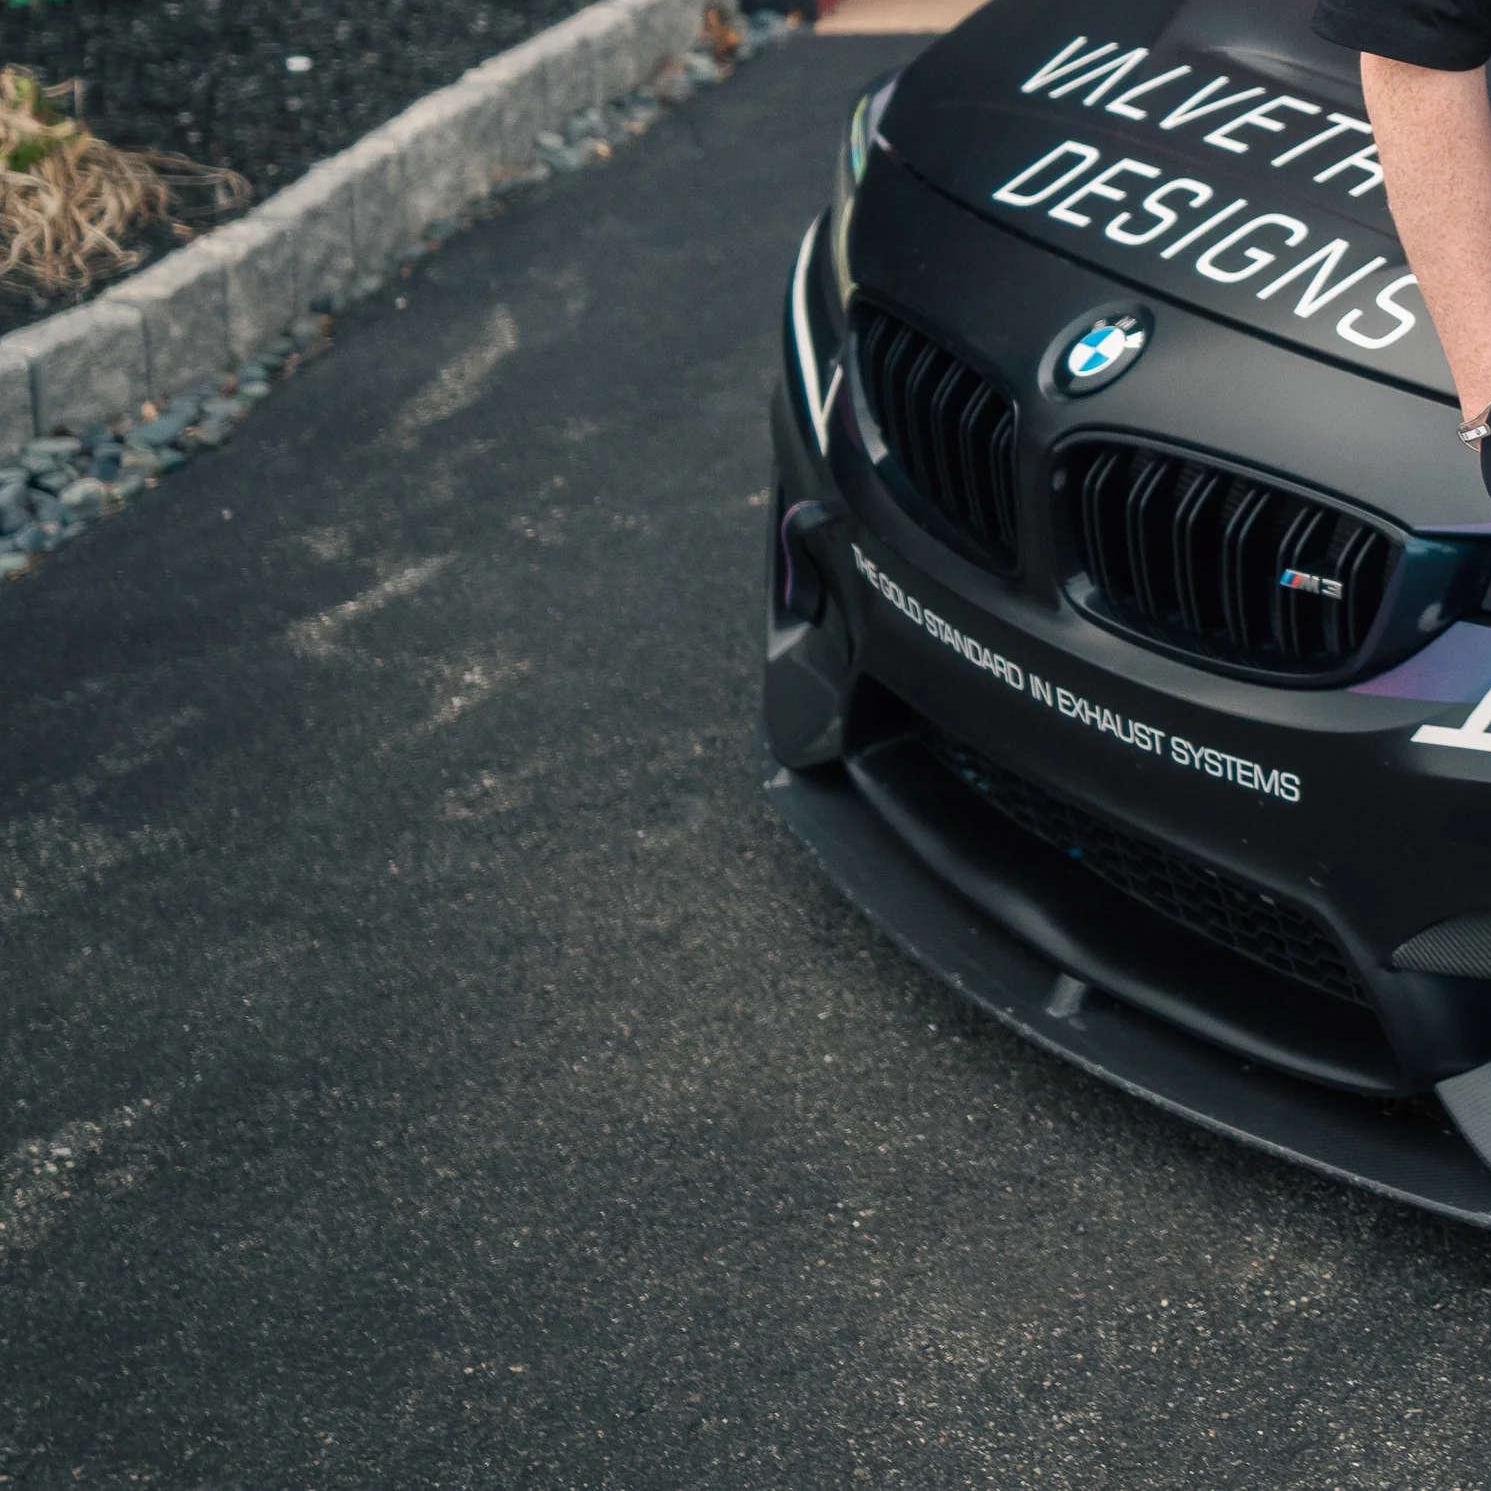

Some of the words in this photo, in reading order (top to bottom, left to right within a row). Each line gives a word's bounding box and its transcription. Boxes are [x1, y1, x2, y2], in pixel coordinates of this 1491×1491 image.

[1020, 35, 1386, 197] VALVETR
[992, 139, 1420, 350] DESIGNS
[851, 542, 880, 590] THE
[878, 572, 923, 625] GOLD
[923, 609, 1025, 691] STANDARD
[1029, 673, 1054, 707] IN
[1055, 686, 1165, 756] EXHAUST
[1170, 737, 1301, 802] SYSTEMS
